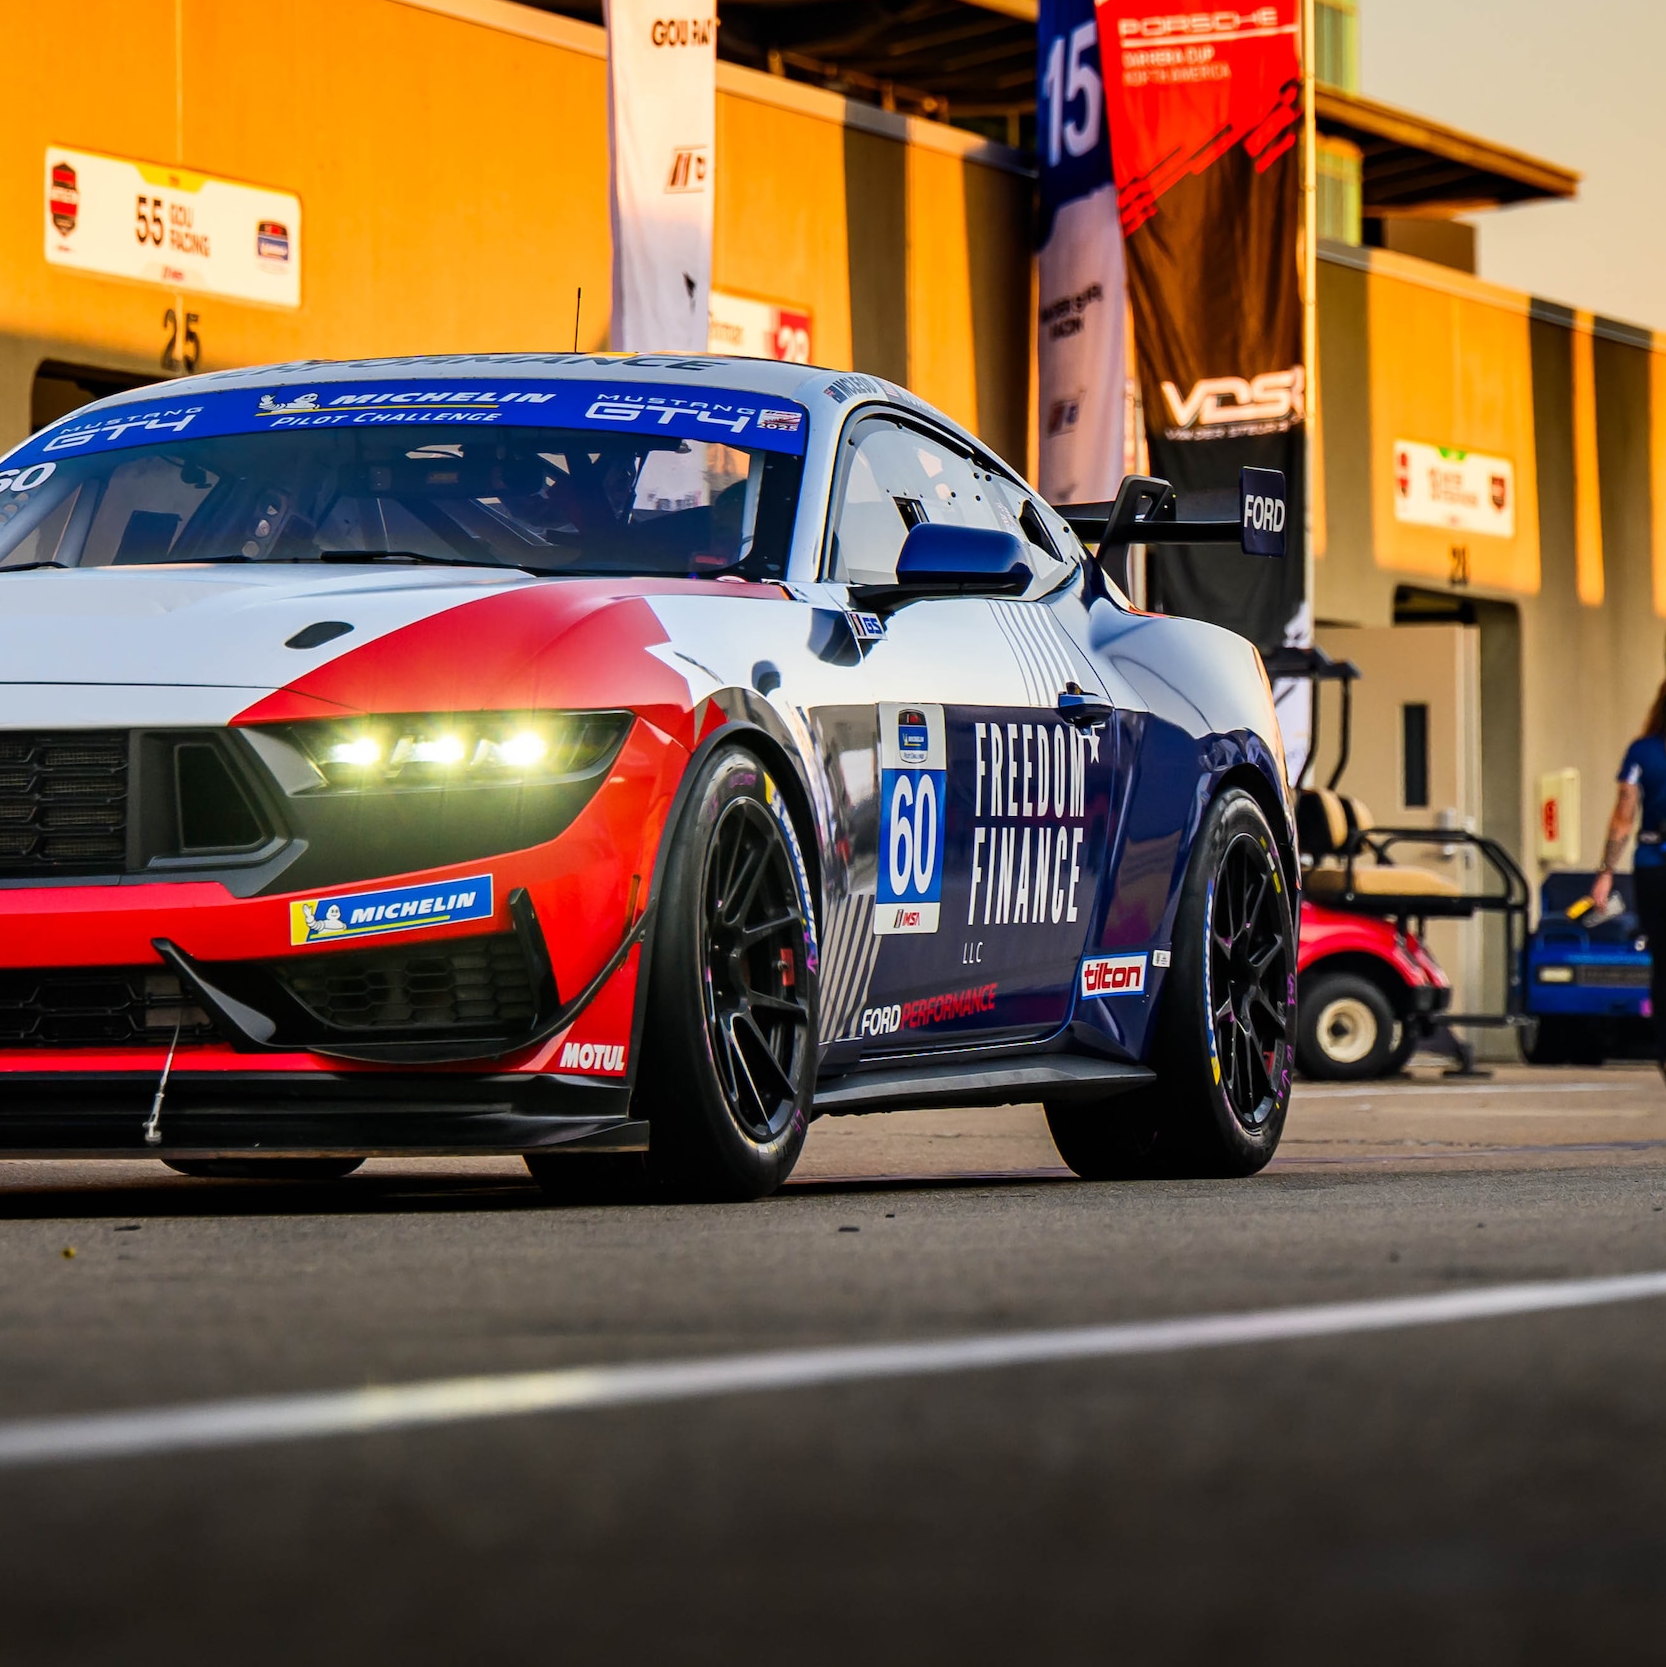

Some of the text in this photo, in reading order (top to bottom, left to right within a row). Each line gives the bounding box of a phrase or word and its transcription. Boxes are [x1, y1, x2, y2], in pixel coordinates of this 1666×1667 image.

[1118, 7, 1277, 37] PORSCHE
[1042, 20, 1101, 166] 15
[136, 196, 163, 246] 55
[328, 392, 557, 406] MICHELIN
[596, 393, 756, 415] MUSTANG
[59, 406, 204, 434] MUSTANG
[269, 411, 503, 427] PILOT CHALLENGE
[584, 401, 750, 433] GT4
[42, 414, 196, 452] GT4
[1244, 495, 1285, 532] FORD
[862, 617, 883, 634] GS
[975, 722, 1085, 819] FREEDOM
[889, 774, 937, 896] 60
[968, 825, 1084, 926] FINANCE
[349, 891, 477, 925] MICHELIN
[961, 941, 983, 965] LLC
[1084, 962, 1141, 991] tilton
[559, 1042, 625, 1071] MOTUL
